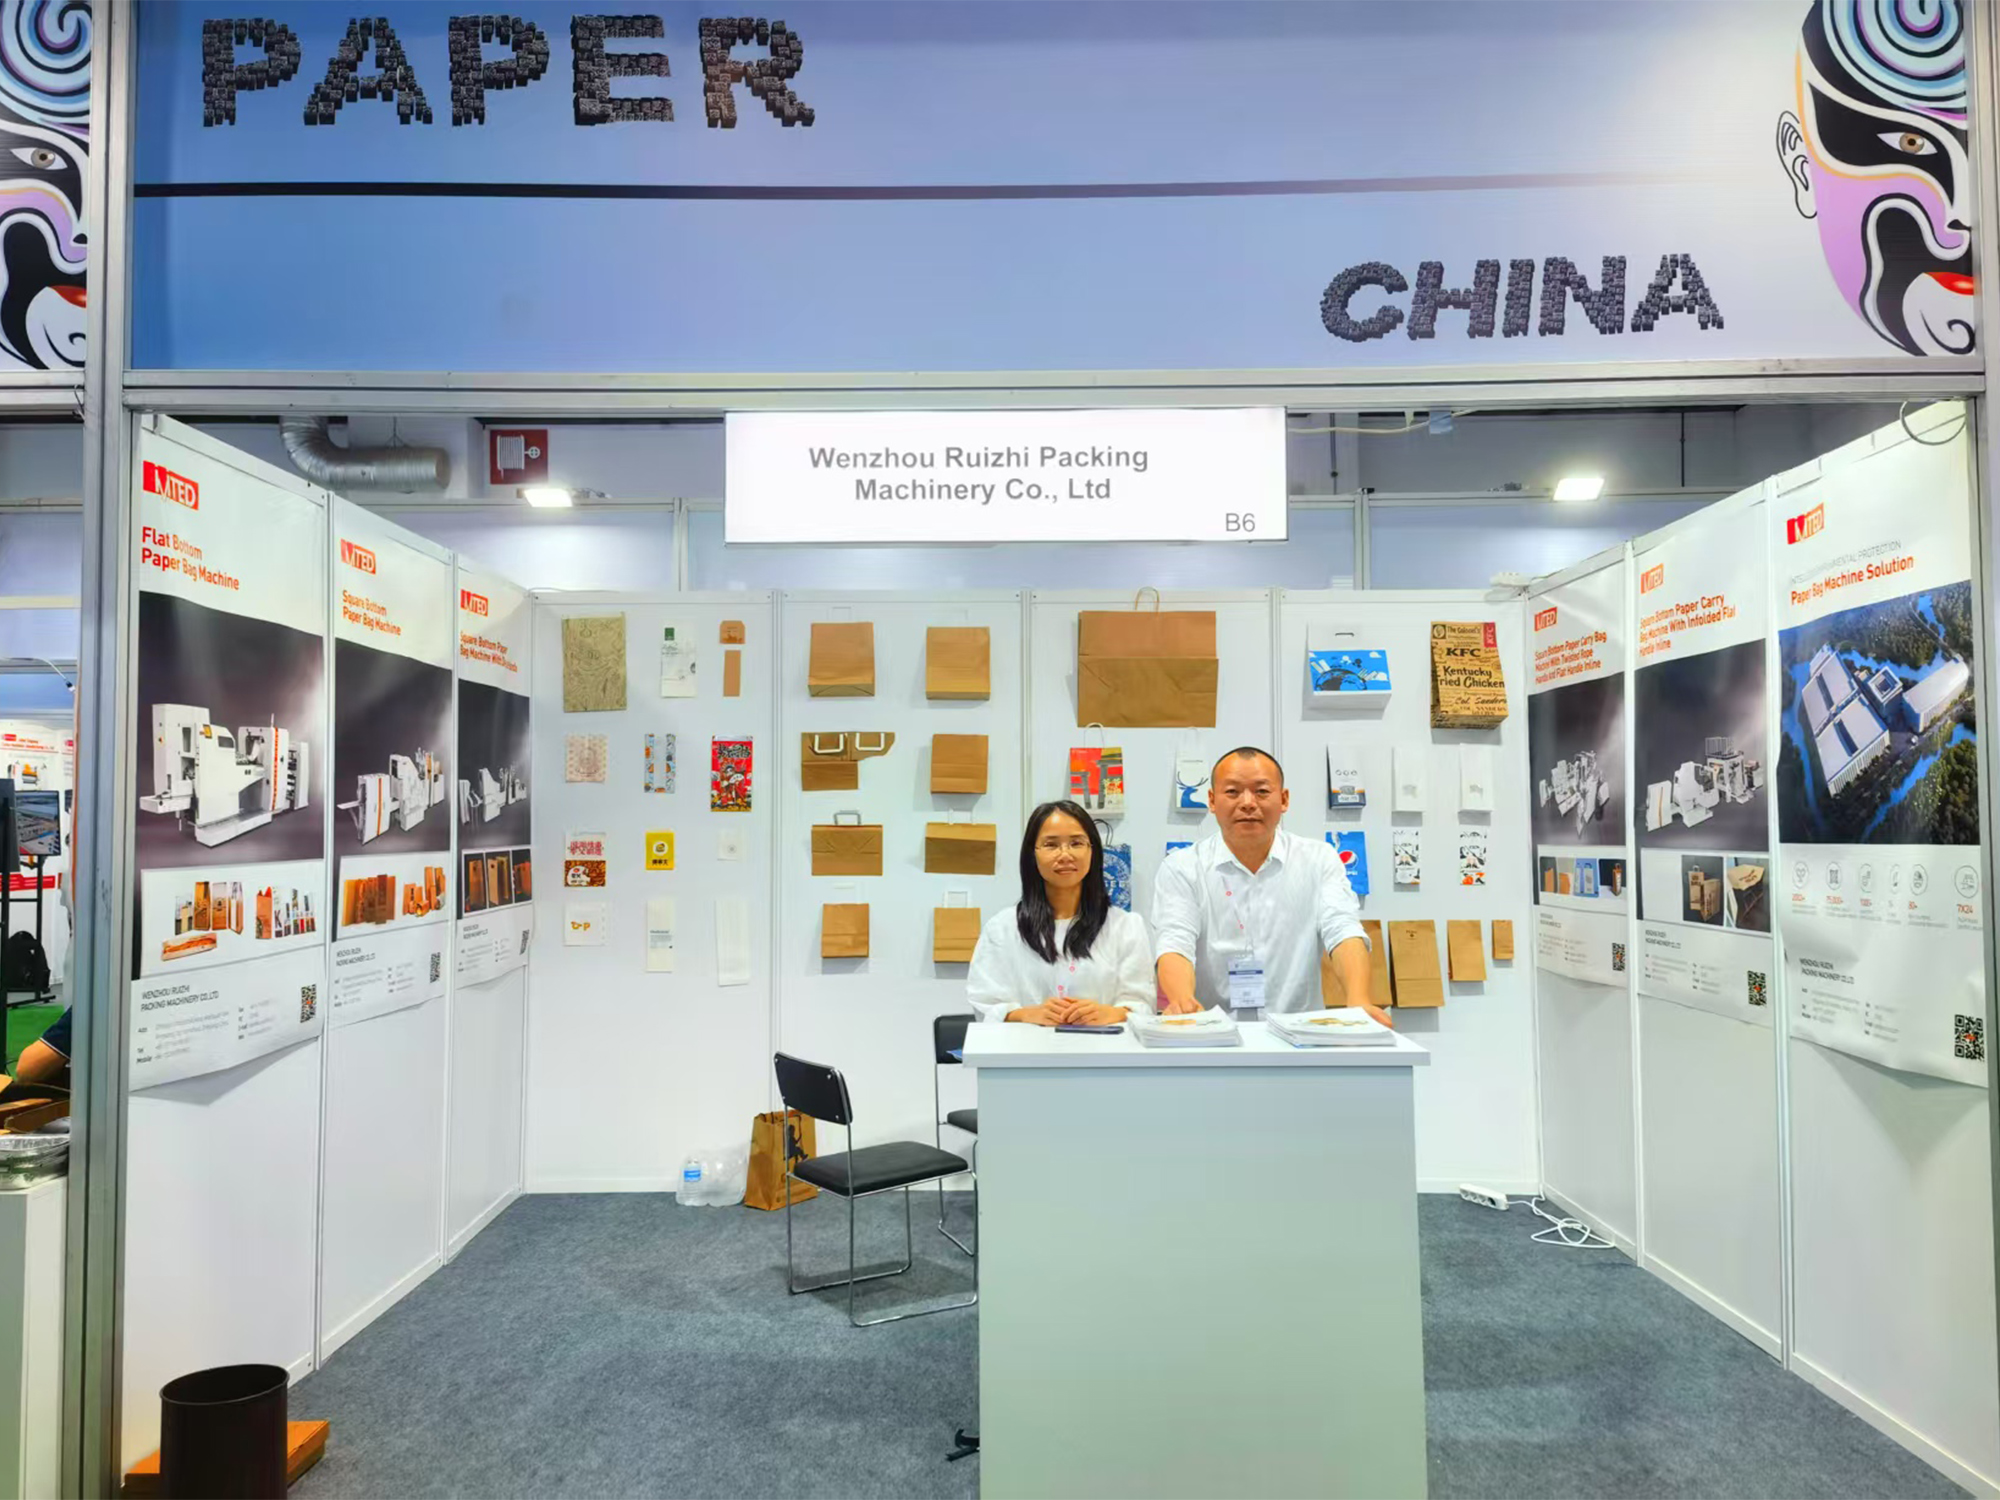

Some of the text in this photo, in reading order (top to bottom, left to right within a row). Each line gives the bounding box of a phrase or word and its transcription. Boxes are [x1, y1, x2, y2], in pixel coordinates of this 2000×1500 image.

[203, 14, 815, 128] PAPER
[1320, 253, 1724, 342] CHINA
[809, 445, 1149, 472] Wenzhou Ruizhi Packing
[855, 478, 1111, 504] Machinery Co., Ltd
[1225, 512, 1256, 533] B6
[142, 526, 202, 560] Flat Bottom
[142, 547, 239, 590] Paper Bag Machine
[1791, 588, 1811, 605] Paper
[1825, 569, 1864, 591] Machine
[1866, 556, 1914, 580] Solution
[343, 606, 362, 623] Paper
[1675, 601, 1699, 615] Paper
[1700, 594, 1724, 608] Carry
[1669, 619, 1686, 632] With
[1687, 609, 1722, 627] Infolded
[1486, 625, 1494, 645] KFC
[1565, 640, 1580, 651] Paper
[1594, 631, 1607, 643] Bag
[1446, 648, 1481, 657] KFC
[1443, 665, 1492, 679] Kentucky
[1463, 676, 1505, 689] Chicken
[167, 993, 199, 1007] MACHINERY
